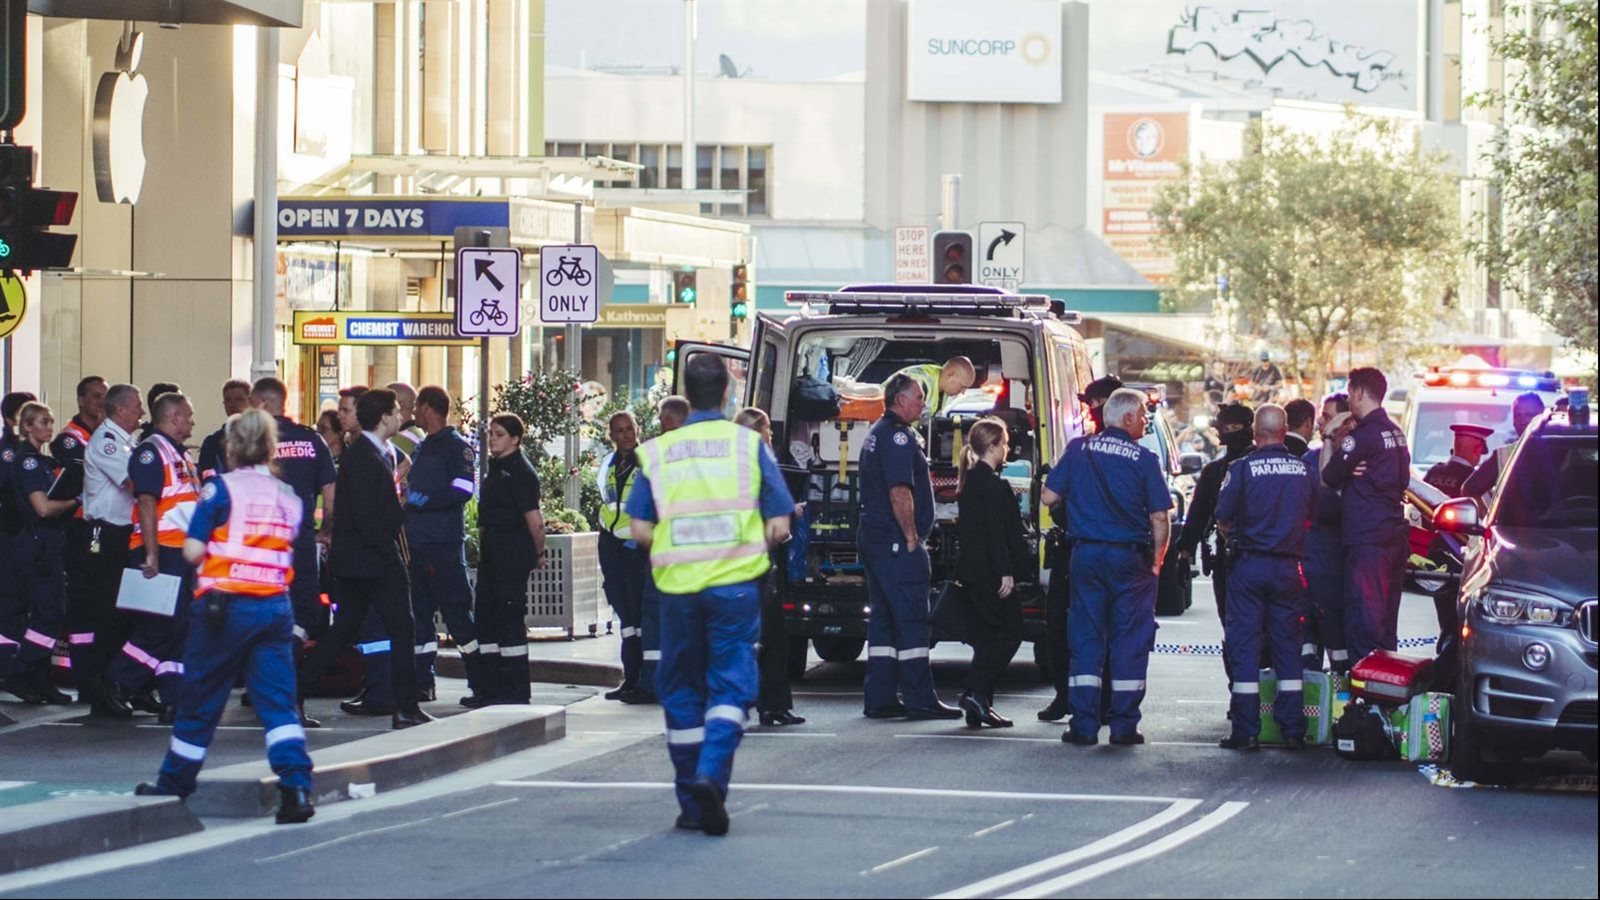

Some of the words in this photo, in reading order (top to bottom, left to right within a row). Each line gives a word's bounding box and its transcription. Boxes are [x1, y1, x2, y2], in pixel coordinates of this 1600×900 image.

[927, 38, 1016, 56] SUNCORP
[278, 208, 340, 229] OPEN
[345, 208, 360, 229] 7
[364, 208, 425, 229] DAYS
[899, 229, 925, 241] STOP
[898, 244, 925, 256] HERE
[982, 266, 1020, 278] ONLY
[549, 295, 589, 312] ONLY
[606, 310, 666, 323] Kathman
[350, 321, 400, 337] CHEMIST
[322, 353, 336, 365] WE
[274, 447, 316, 458] AMEDIC
[1251, 463, 1307, 477] PARAMEDIC
